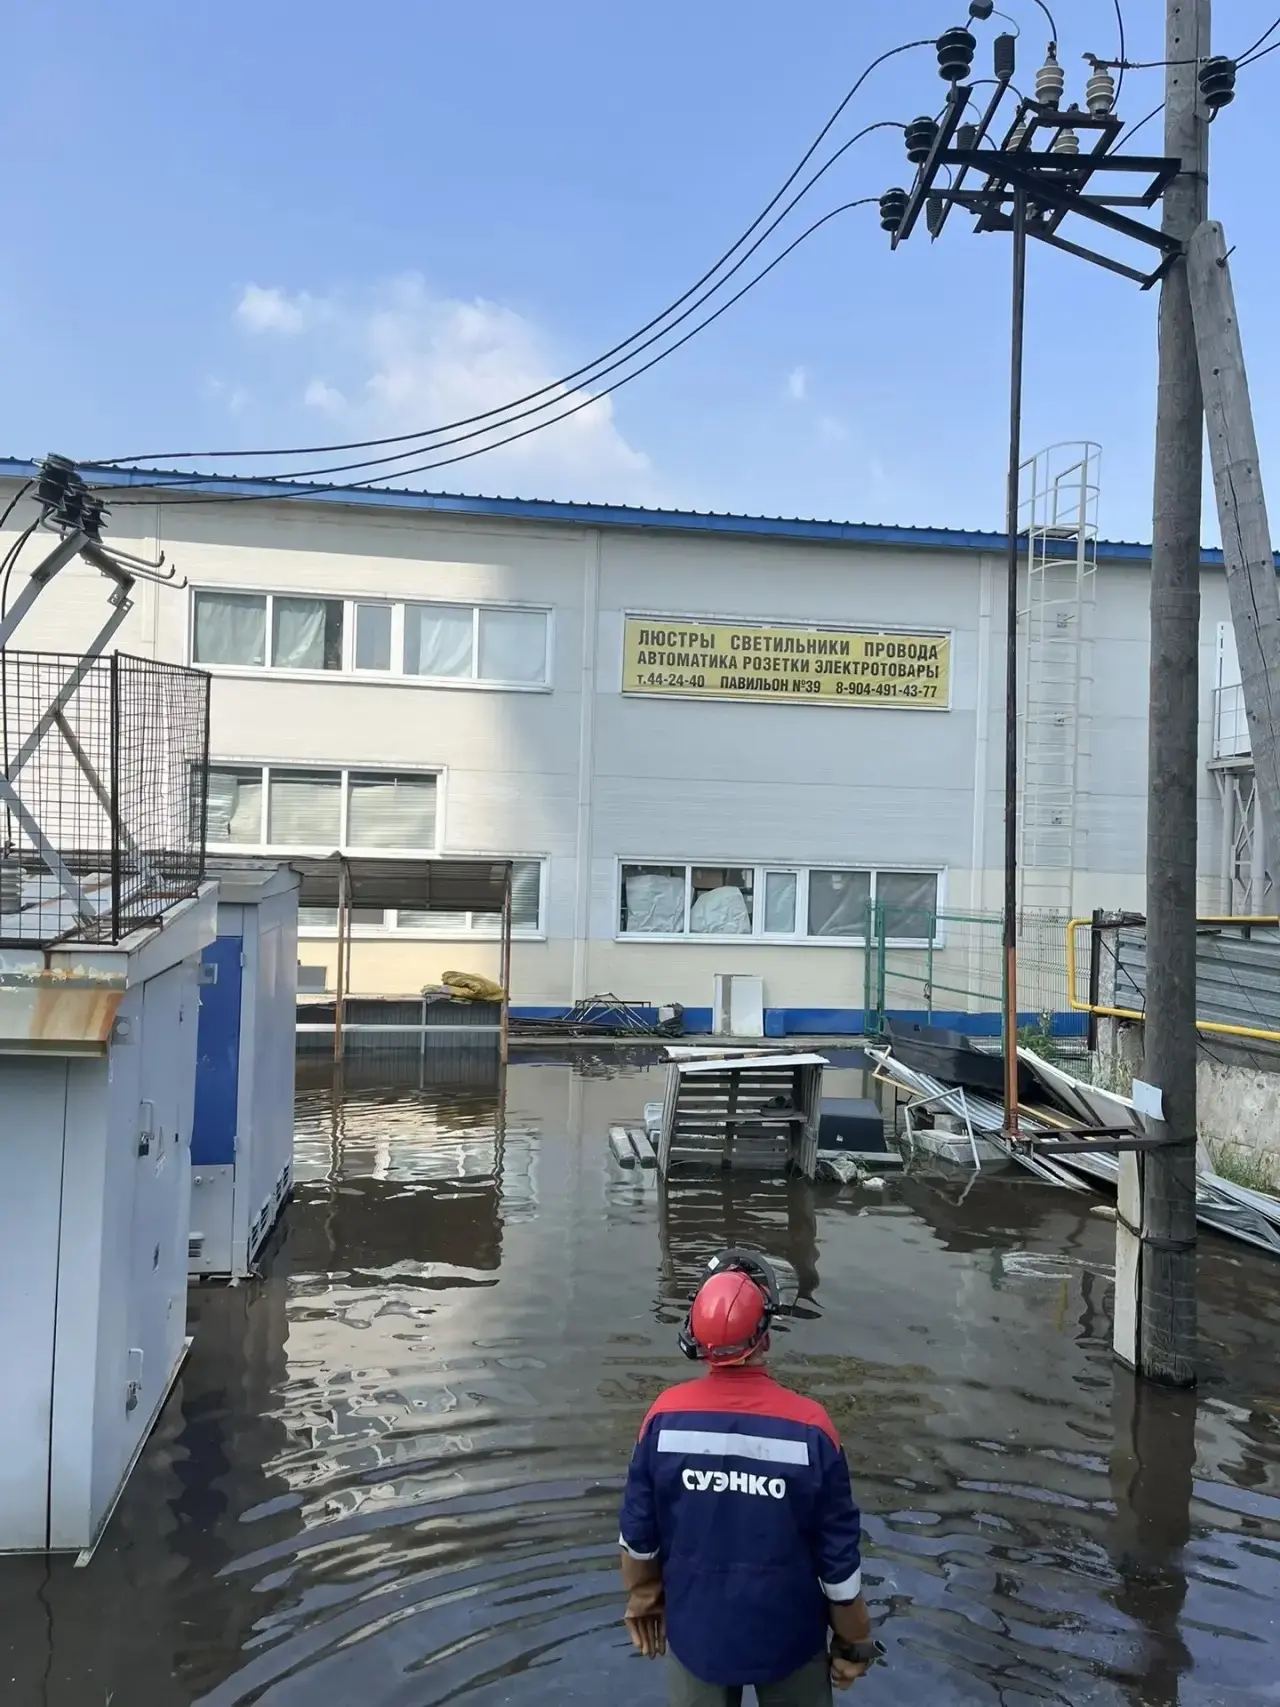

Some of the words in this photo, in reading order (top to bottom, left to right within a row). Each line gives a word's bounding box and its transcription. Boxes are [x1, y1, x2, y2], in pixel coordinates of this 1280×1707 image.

[638, 629, 715, 649] ЛЮСТРЫ
[730, 634, 850, 656] СВЕТИЛЬНИКИ
[864, 641, 938, 661] ПРОВОДА
[637, 650, 738, 669] АВТОМАТИКА
[743, 656, 810, 673] РОЗЕТКИ
[814, 659, 939, 679] ЭЛЕКТРОТОВАРЫ
[720, 675, 789, 692] ПАВИЛЬОН
[836, 681, 938, 698] 8-904-491-43-77
[682, 1468, 786, 1499] СУЭНКО
